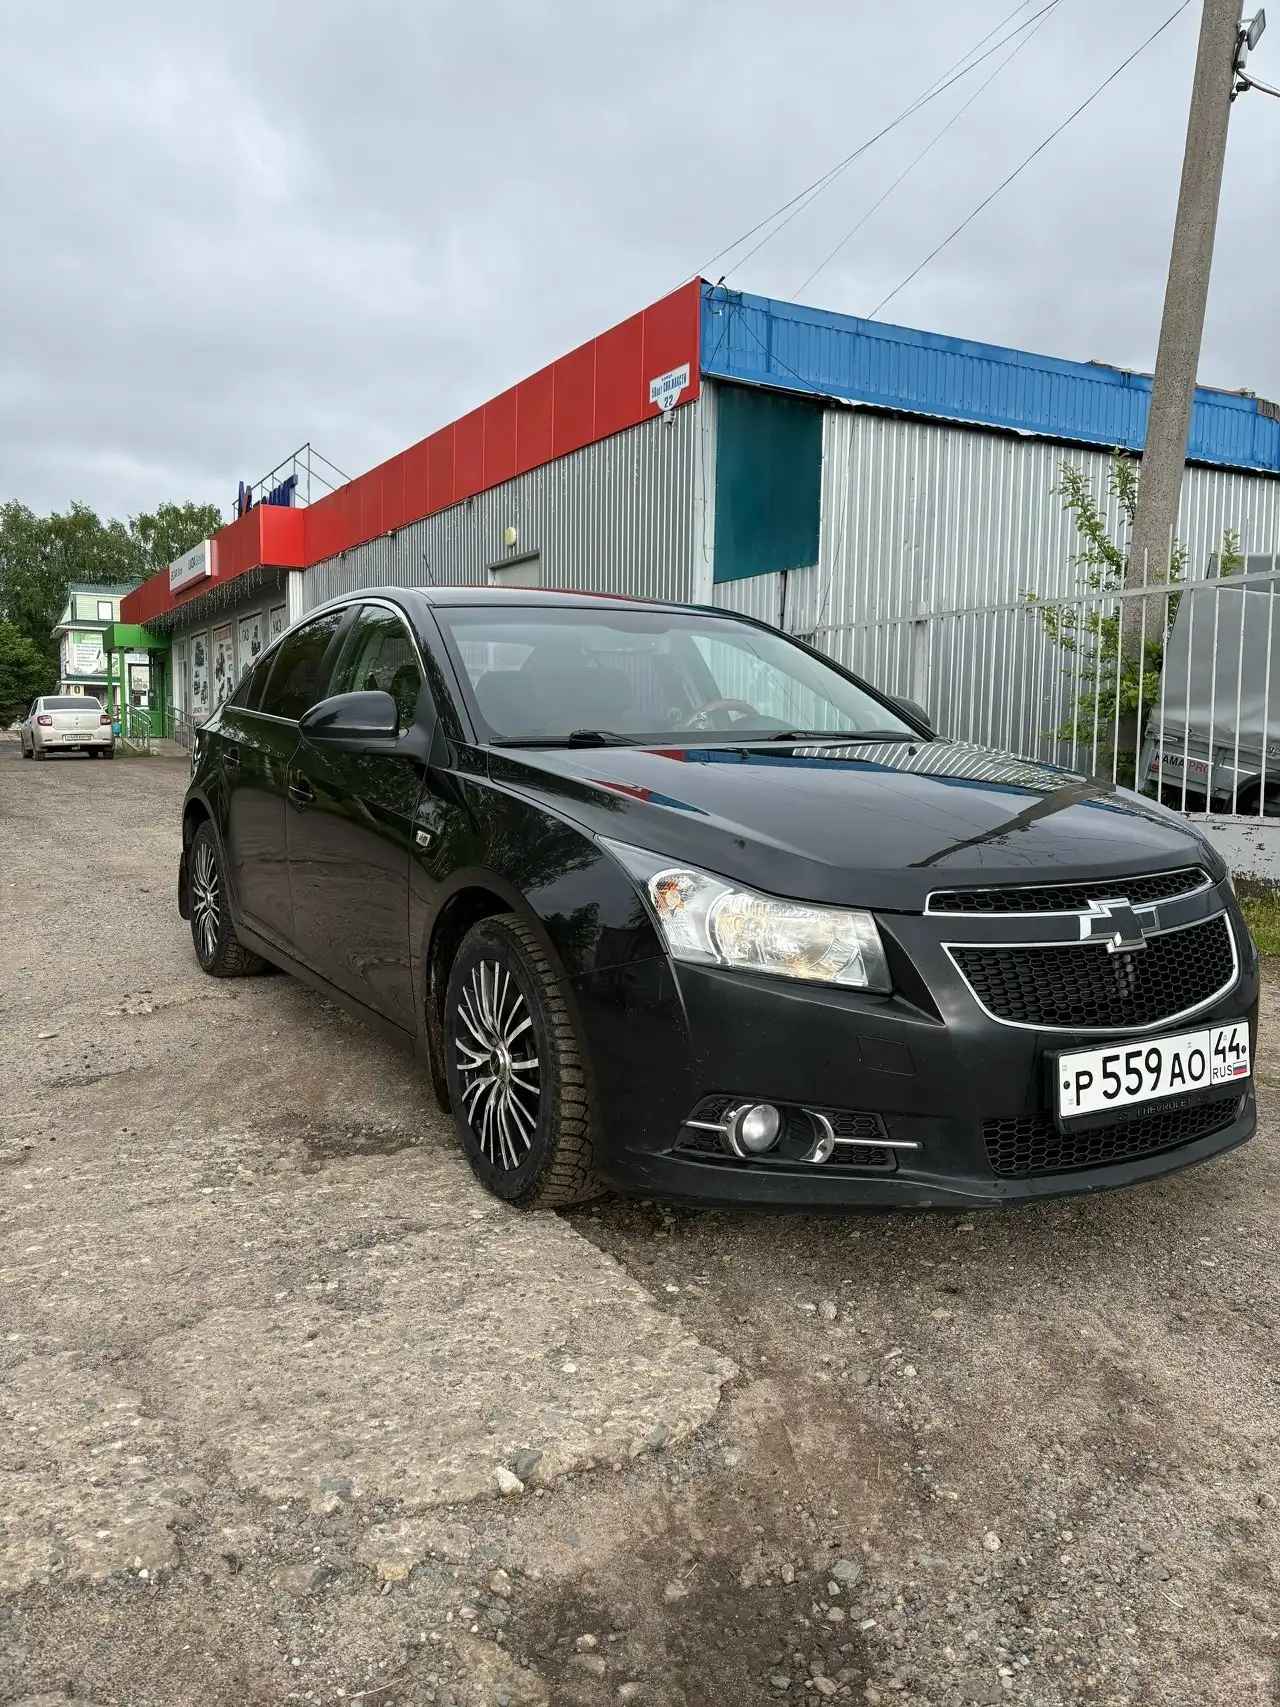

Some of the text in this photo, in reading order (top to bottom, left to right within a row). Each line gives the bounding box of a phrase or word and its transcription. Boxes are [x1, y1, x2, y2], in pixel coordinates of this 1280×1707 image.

[664, 394, 674, 408] 22
[1214, 1028, 1240, 1063] 44
[1213, 1064, 1233, 1080] RUS
[1137, 1097, 1193, 1117] CHEVROLET
